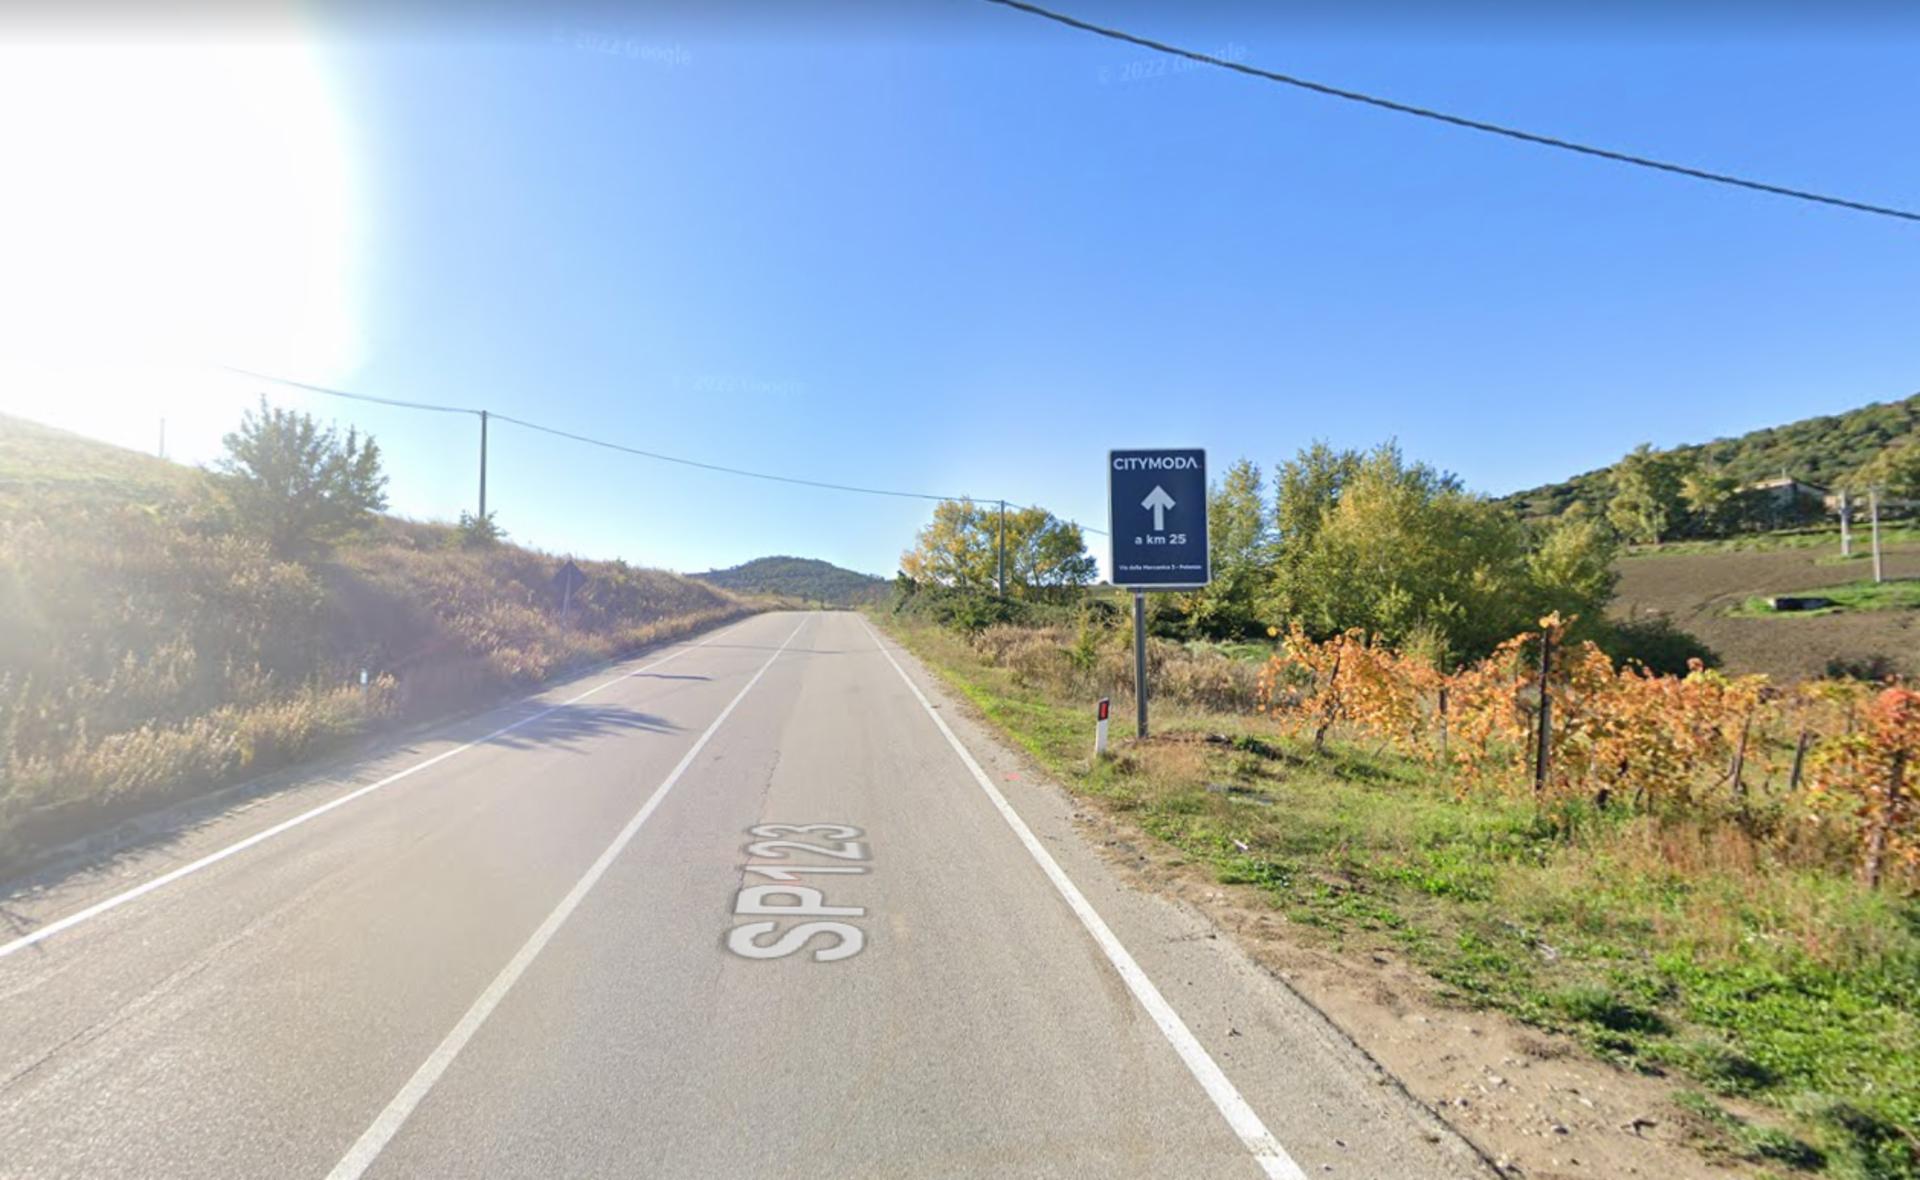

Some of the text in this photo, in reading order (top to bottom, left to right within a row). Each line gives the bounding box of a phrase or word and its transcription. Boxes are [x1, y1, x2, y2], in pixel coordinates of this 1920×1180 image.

[1113, 457, 1198, 470] CITYMODA
[1134, 533, 1187, 545] a km 25
